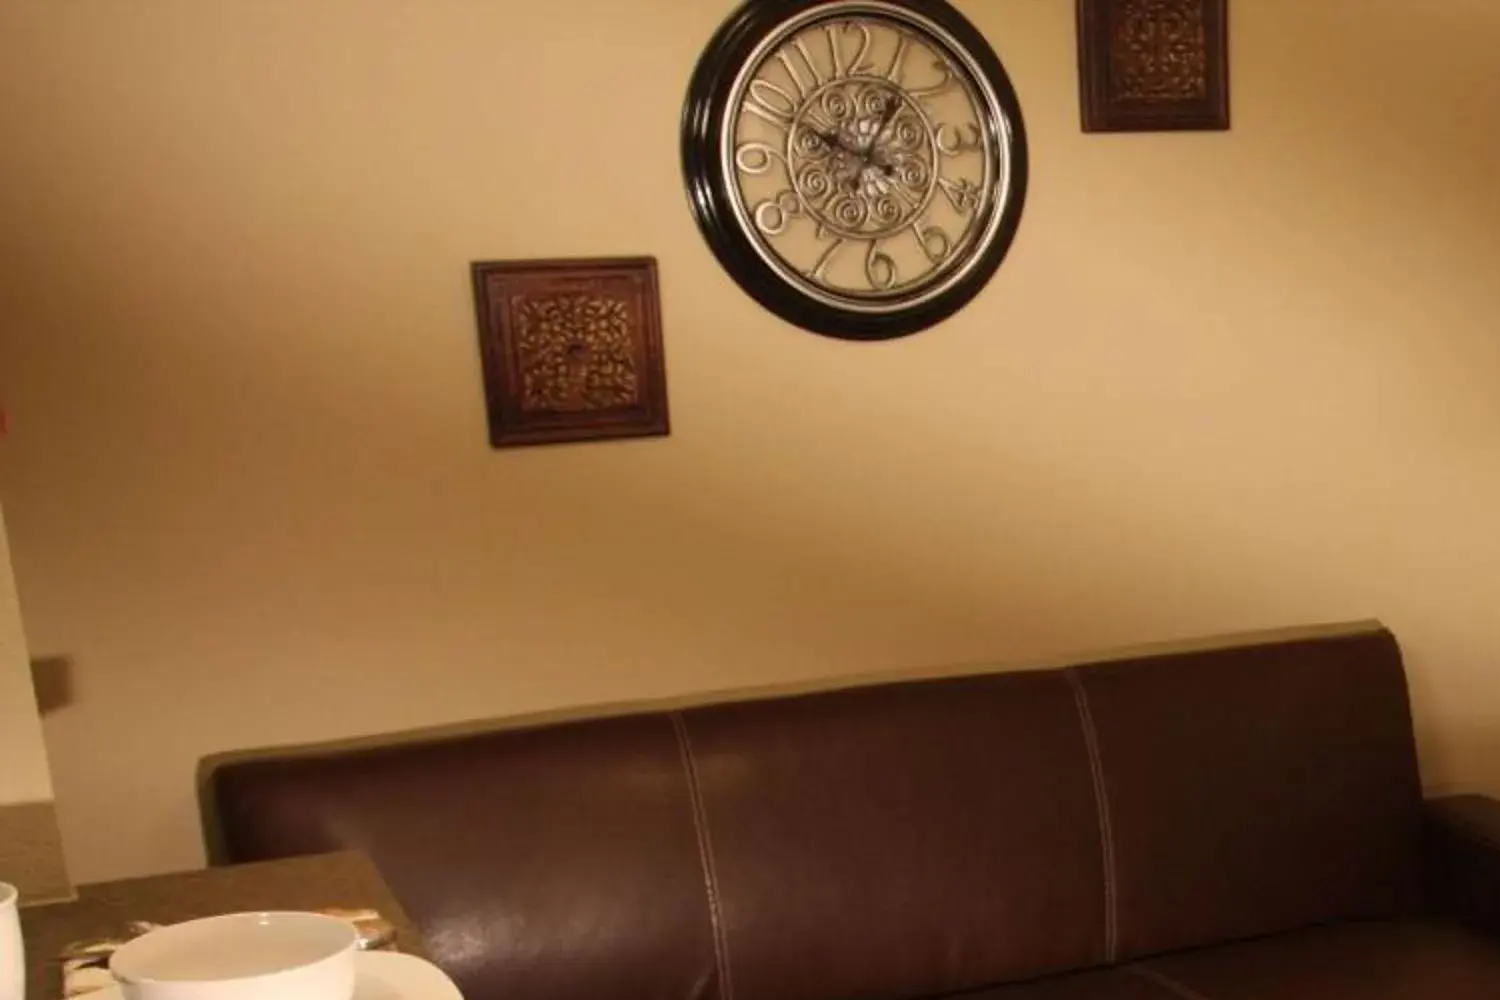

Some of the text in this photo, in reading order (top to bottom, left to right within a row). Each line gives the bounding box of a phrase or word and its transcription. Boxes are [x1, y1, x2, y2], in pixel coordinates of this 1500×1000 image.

[775, 37, 822, 98] 11
[824, 22, 880, 79] 12
[887, 34, 911, 83] 1
[742, 79, 797, 131] 10
[736, 142, 789, 174] 9
[934, 121, 982, 157] 3
[755, 190, 800, 235] 8
[865, 239, 897, 291] 6
